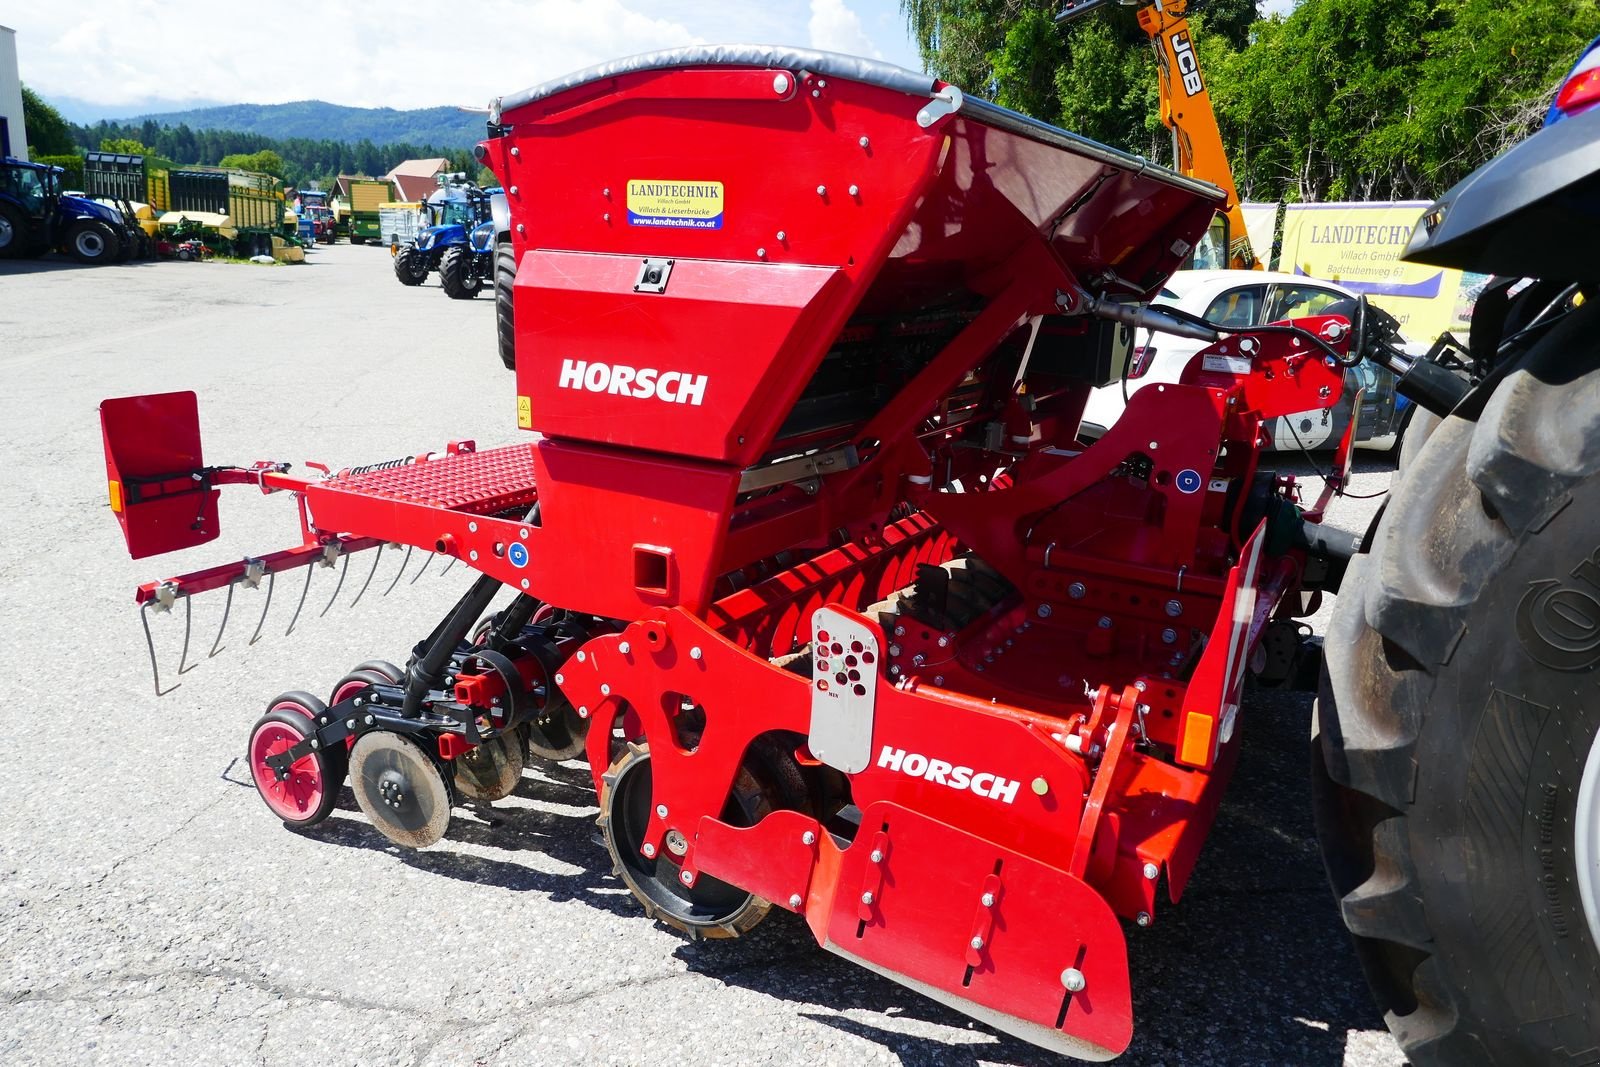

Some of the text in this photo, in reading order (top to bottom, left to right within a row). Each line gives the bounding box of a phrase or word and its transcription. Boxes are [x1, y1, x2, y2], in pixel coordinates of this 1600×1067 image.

[1172, 34, 1202, 96] JCB
[631, 184, 719, 198] LANDTECHNIK
[638, 206, 661, 214] Villach
[667, 207, 710, 215] Lieserbrücke
[633, 217, 716, 228] www.landtechnik.co.at
[1311, 225, 1411, 245] LANDTECHN
[1340, 250, 1400, 261] Villach GmbH
[1327, 264, 1391, 277] Badstubenweg
[558, 358, 708, 406] HORSCH
[876, 745, 1021, 804] HORSCH
